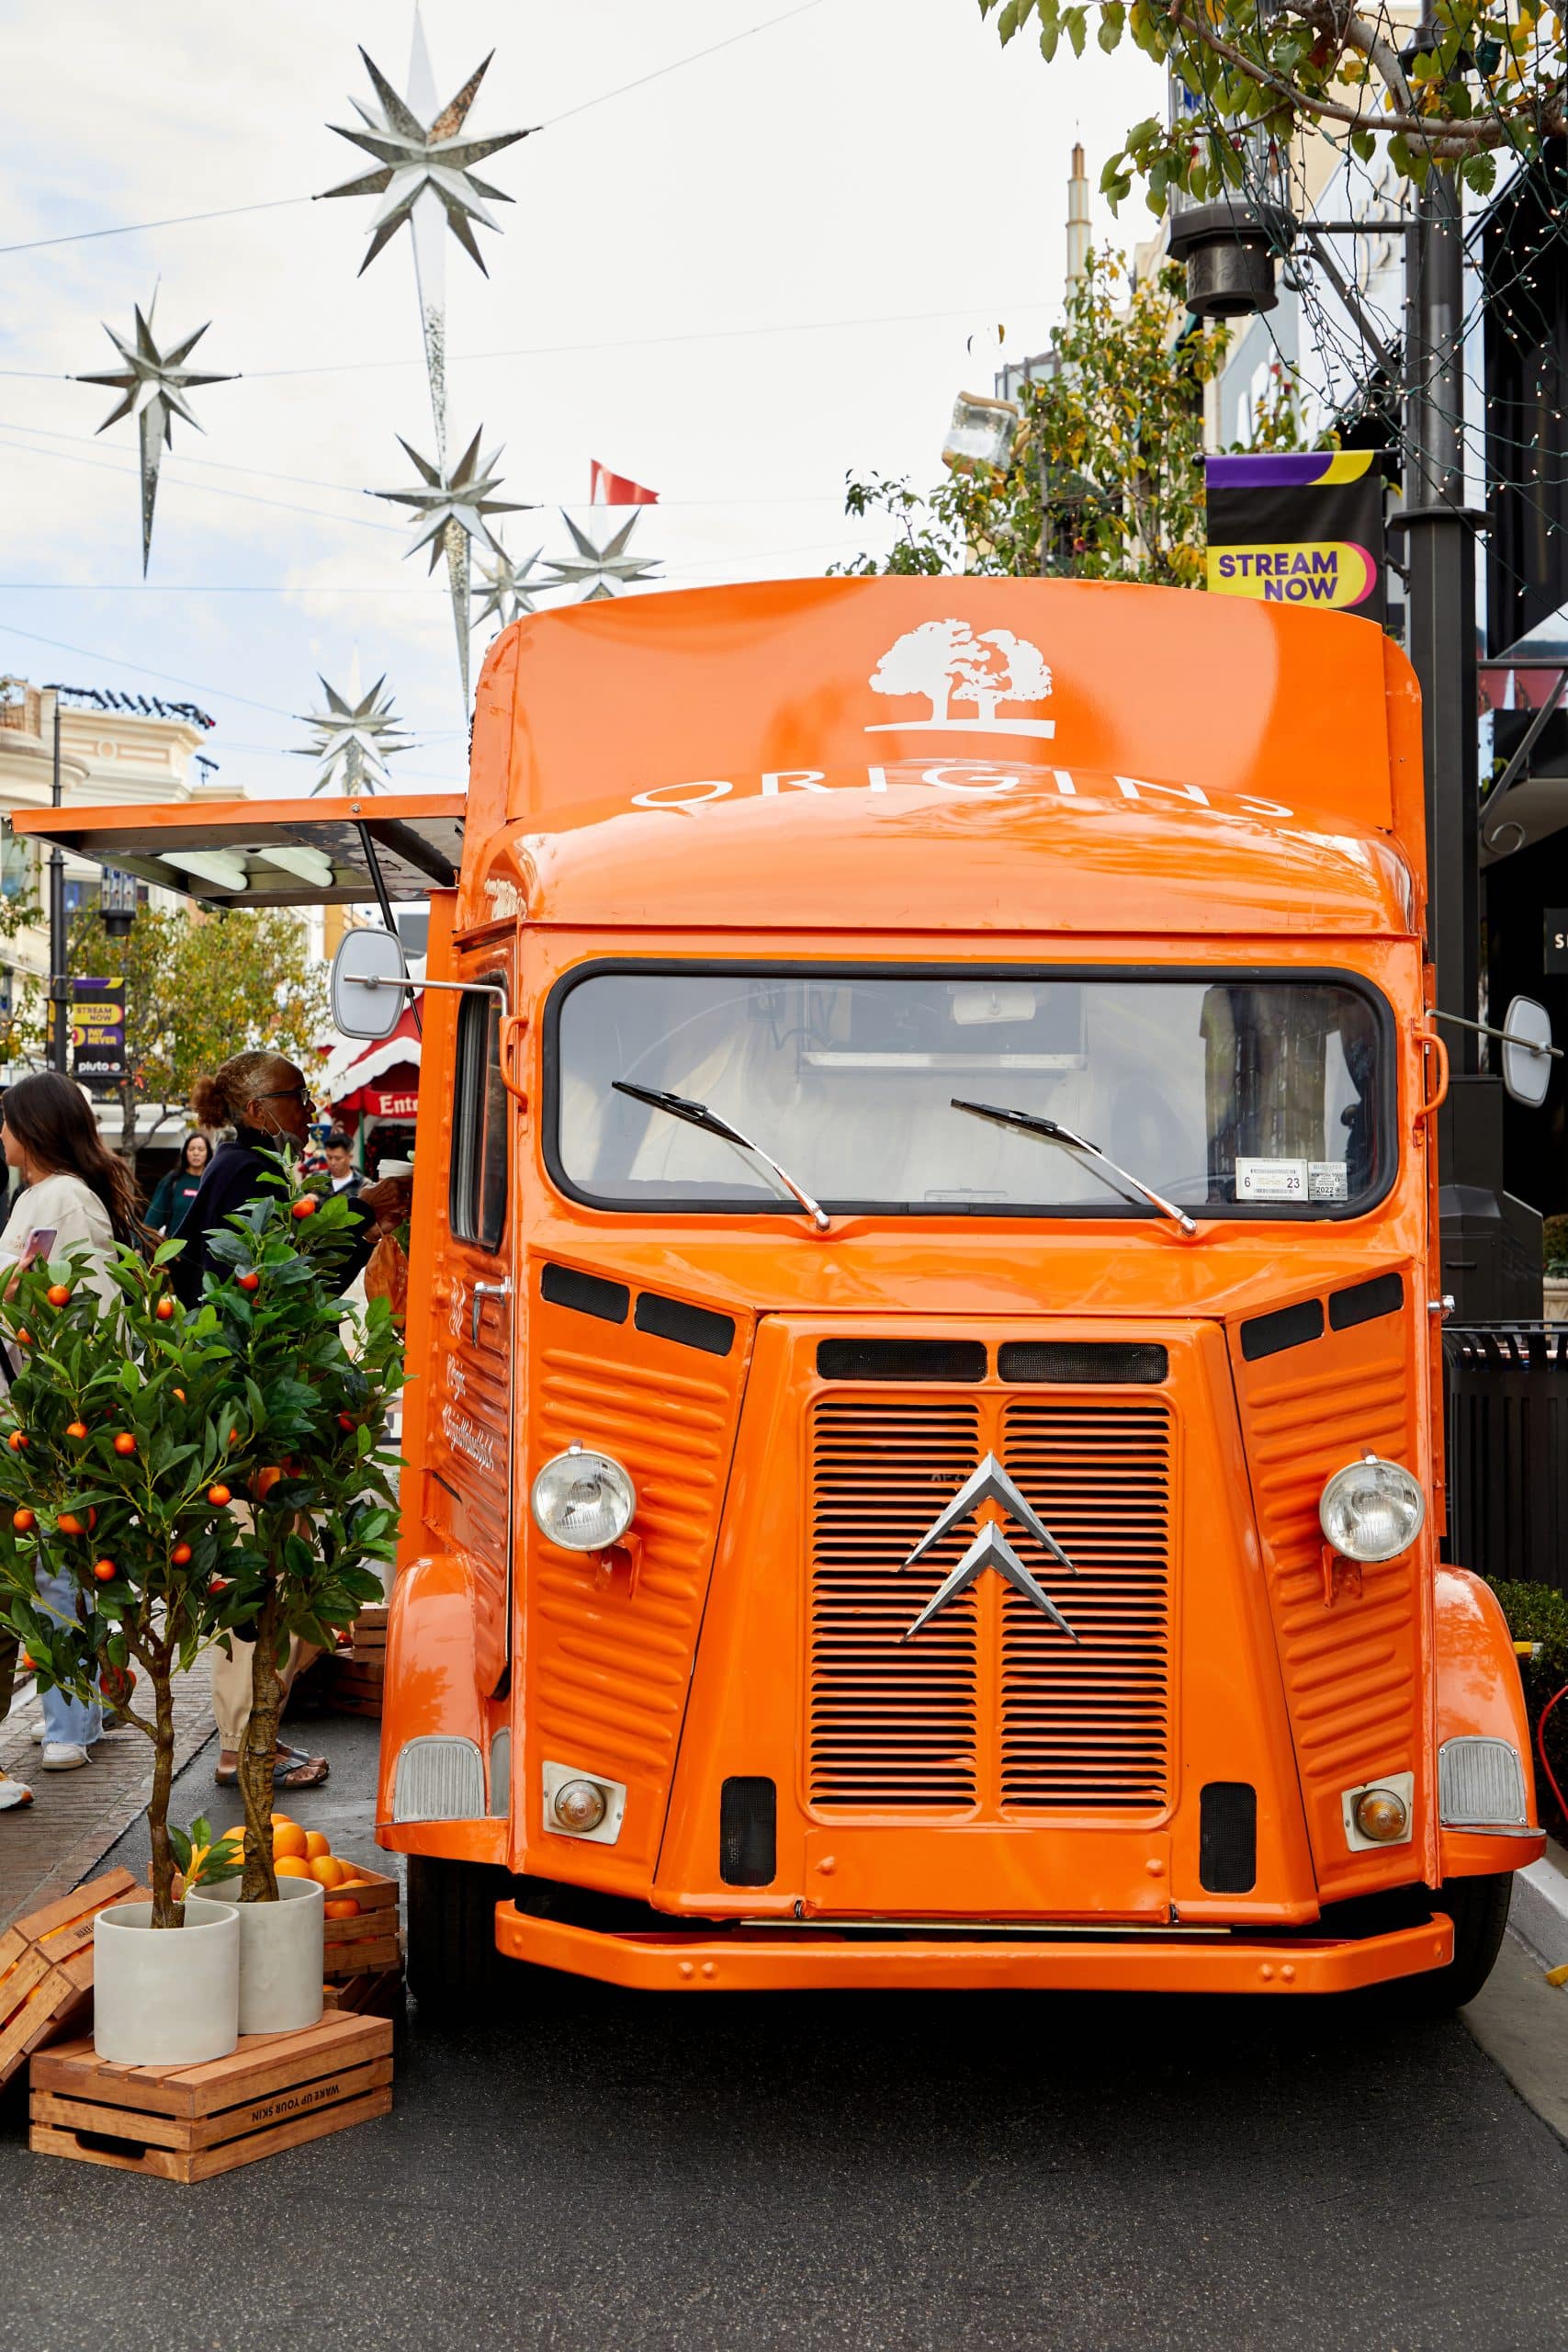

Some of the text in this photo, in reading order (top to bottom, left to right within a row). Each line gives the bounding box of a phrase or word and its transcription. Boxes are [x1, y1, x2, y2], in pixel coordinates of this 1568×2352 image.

[1219, 551, 1337, 578] STREAM
[1264, 577, 1338, 601] NOW
[631, 765, 1294, 817] ORIGINS
[78, 1060, 109, 1073] pluto
[1244, 1177, 1301, 1189] 6 23
[253, 2084, 340, 2121] WAKE UP YOUR SKIN
